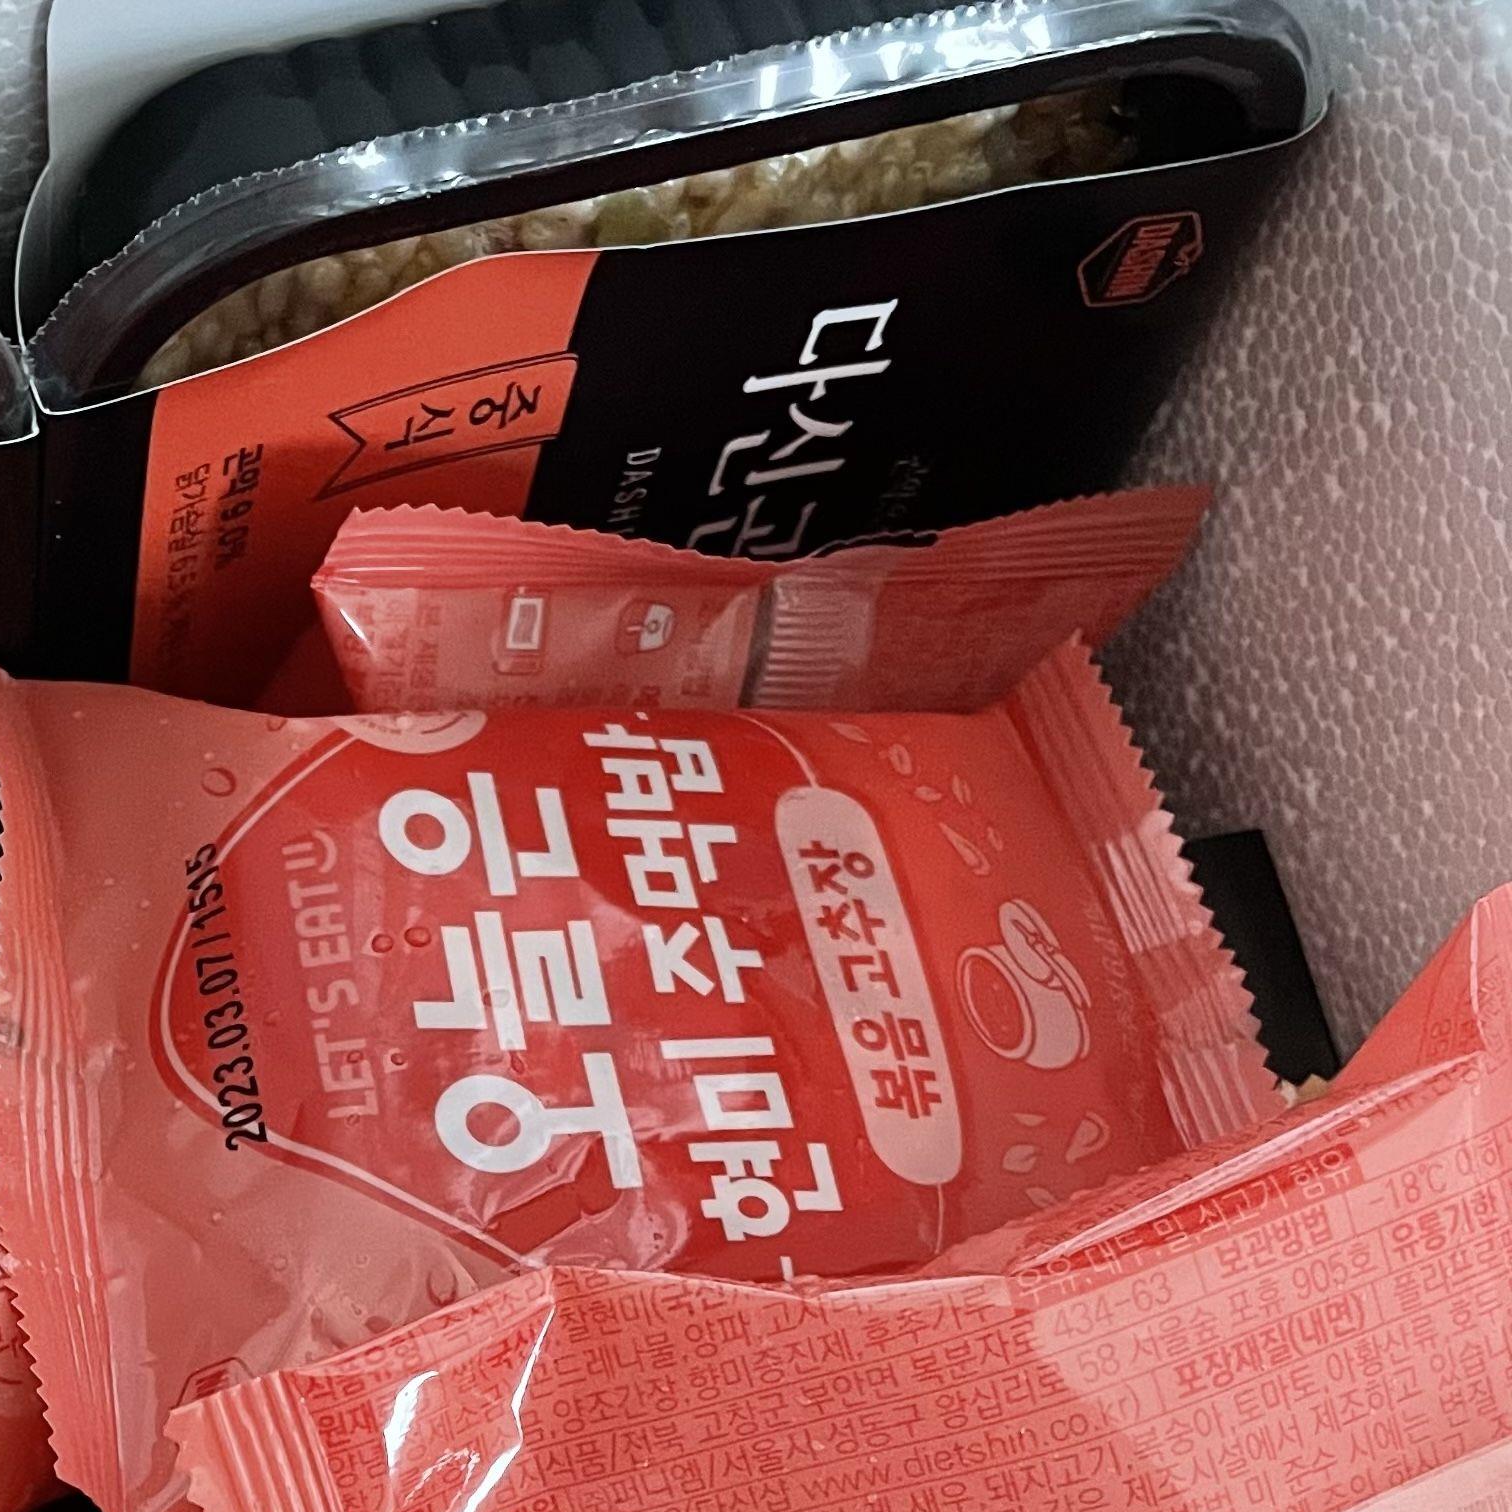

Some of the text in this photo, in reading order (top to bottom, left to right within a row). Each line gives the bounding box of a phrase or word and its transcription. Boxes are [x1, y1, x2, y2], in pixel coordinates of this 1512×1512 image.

[196, 952, 267, 1150] 2023.03.07
[307, 978, 377, 1117] LET'S
[379, 772, 643, 1192] 오늘은
[583, 723, 844, 1243] 현미주먹밥
[1290, 1148, 1353, 1198] 함유
[697, 1393, 791, 1443] 고창군
[800, 1365, 901, 1417] 부안면
[907, 1321, 1037, 1388] 복분자로
[1049, 1274, 1176, 1339] 434-63
[1213, 1207, 1335, 1278] 보관방법
[832, 1403, 926, 1453] 성동구
[933, 1360, 1069, 1428] 왕십리로
[1077, 1342, 1120, 1384] 58
[1130, 1309, 1221, 1364] 서울숲
[1290, 1242, 1379, 1300] 905호
[1386, 1189, 1502, 1261] 유통기한
[1307, 1369, 1424, 1436] 제조하고
